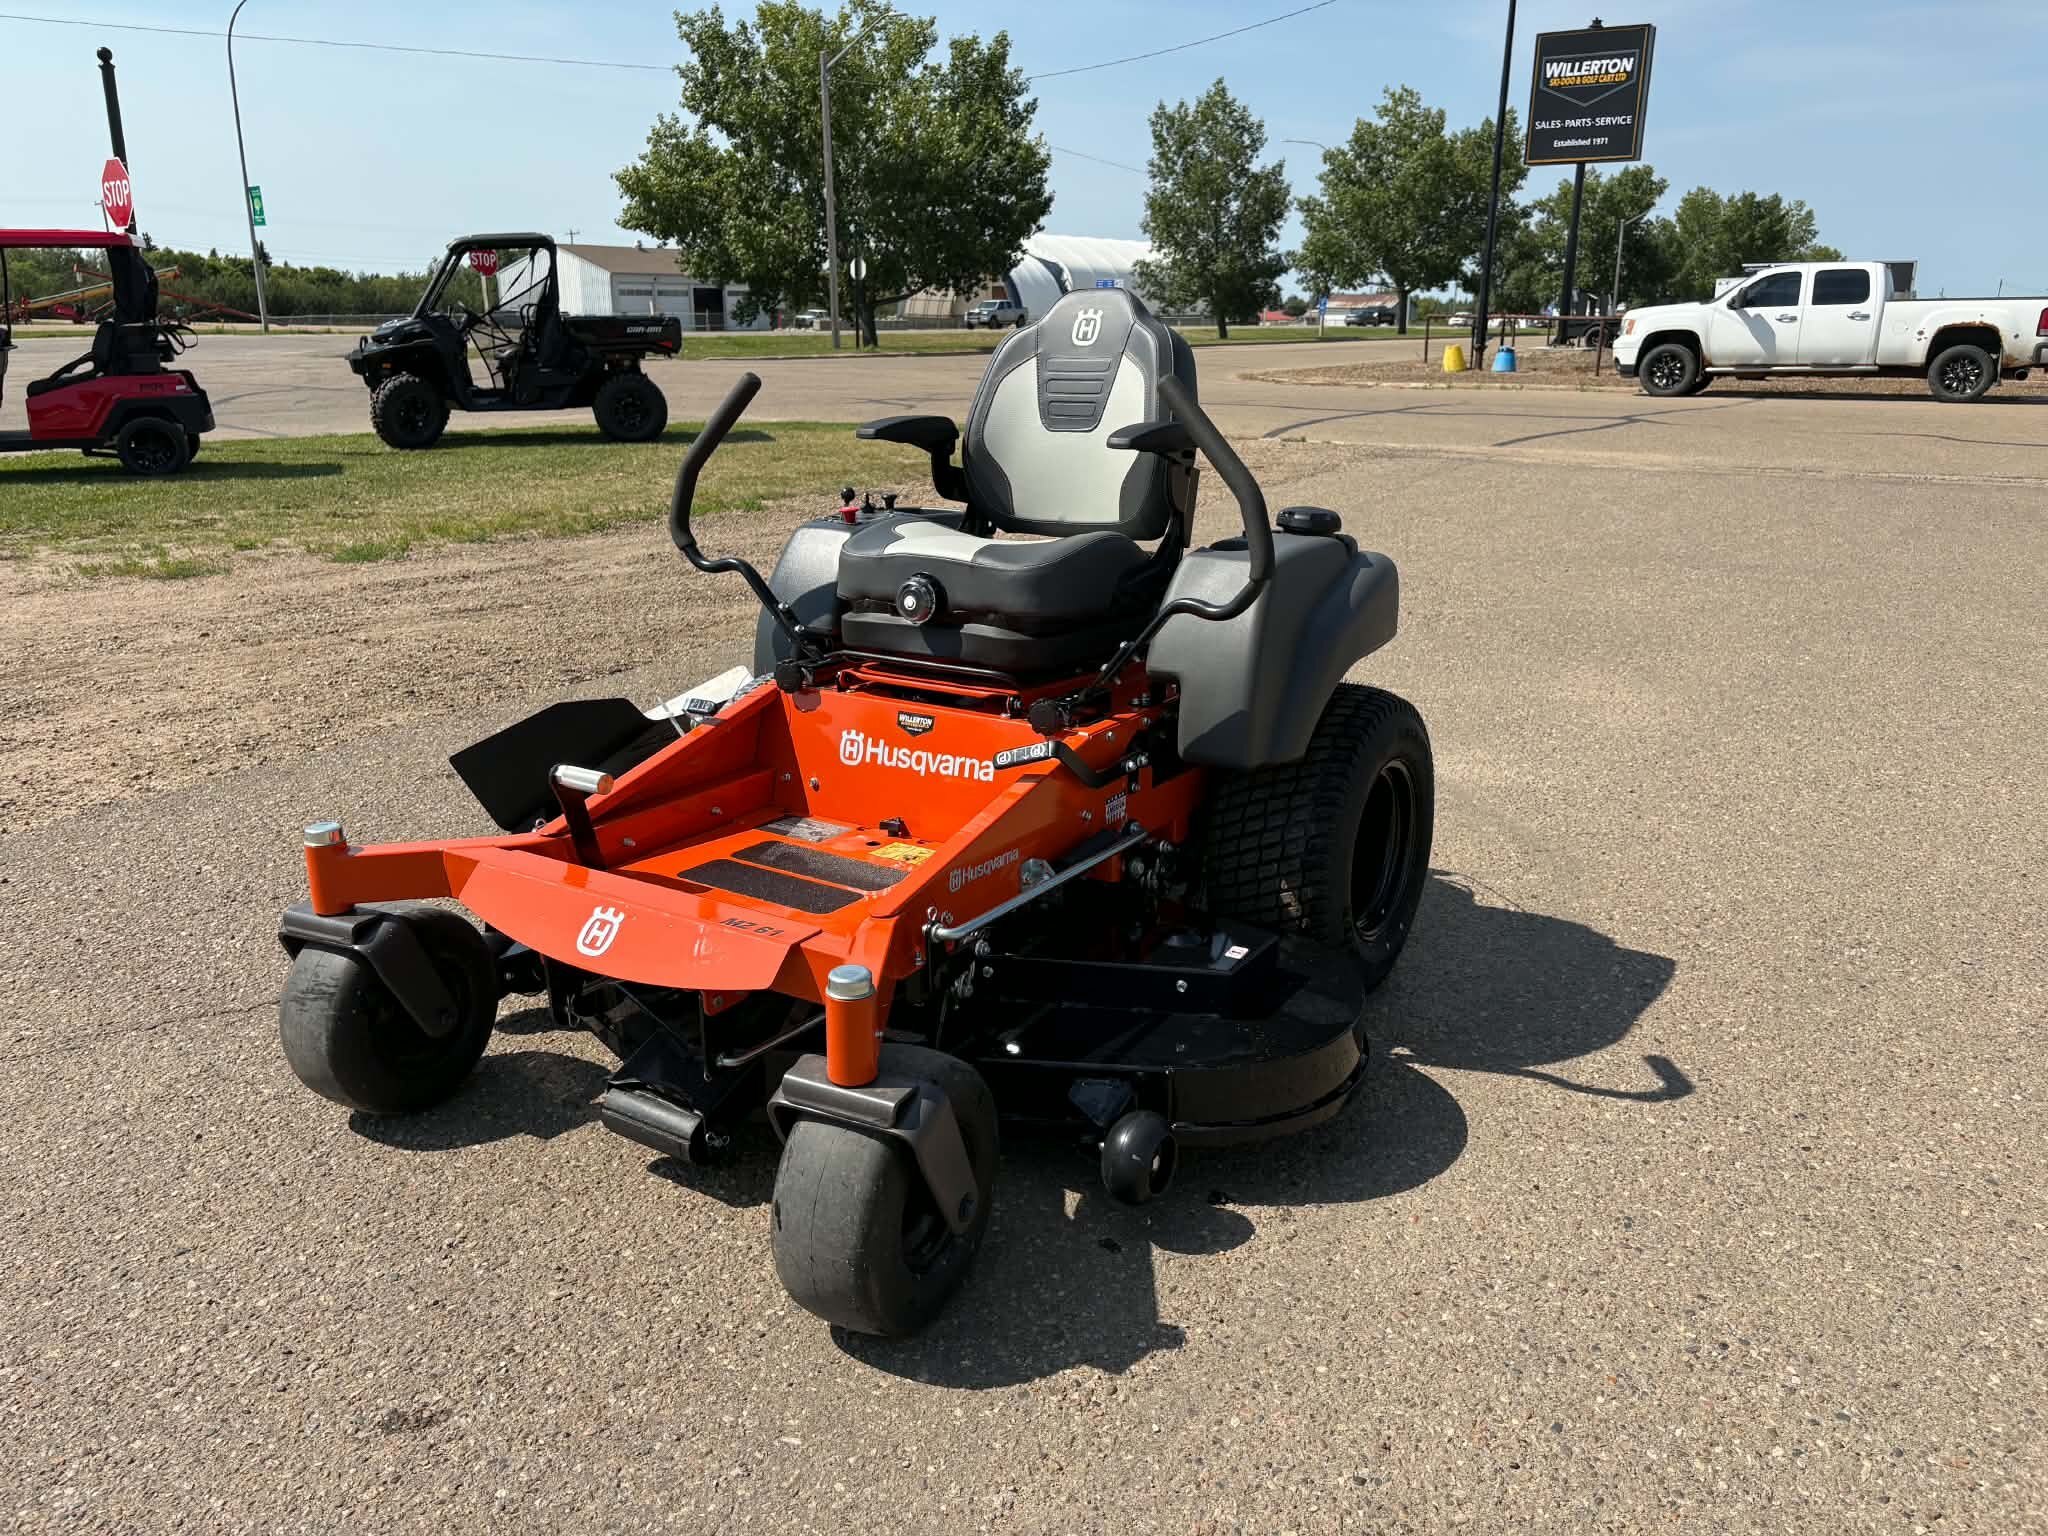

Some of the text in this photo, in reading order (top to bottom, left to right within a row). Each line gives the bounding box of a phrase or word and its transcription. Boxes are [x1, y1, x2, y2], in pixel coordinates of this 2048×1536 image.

[1545, 57, 1634, 78] WILLERTON
[1553, 138, 1591, 148] Established
[104, 180, 129, 207] STOP
[471, 252, 497, 267] STOP
[899, 713, 933, 727] WILLERTON
[865, 736, 995, 782] Husqvarna
[963, 847, 1018, 886] Husqvarna
[720, 918, 785, 937] MZ 61
